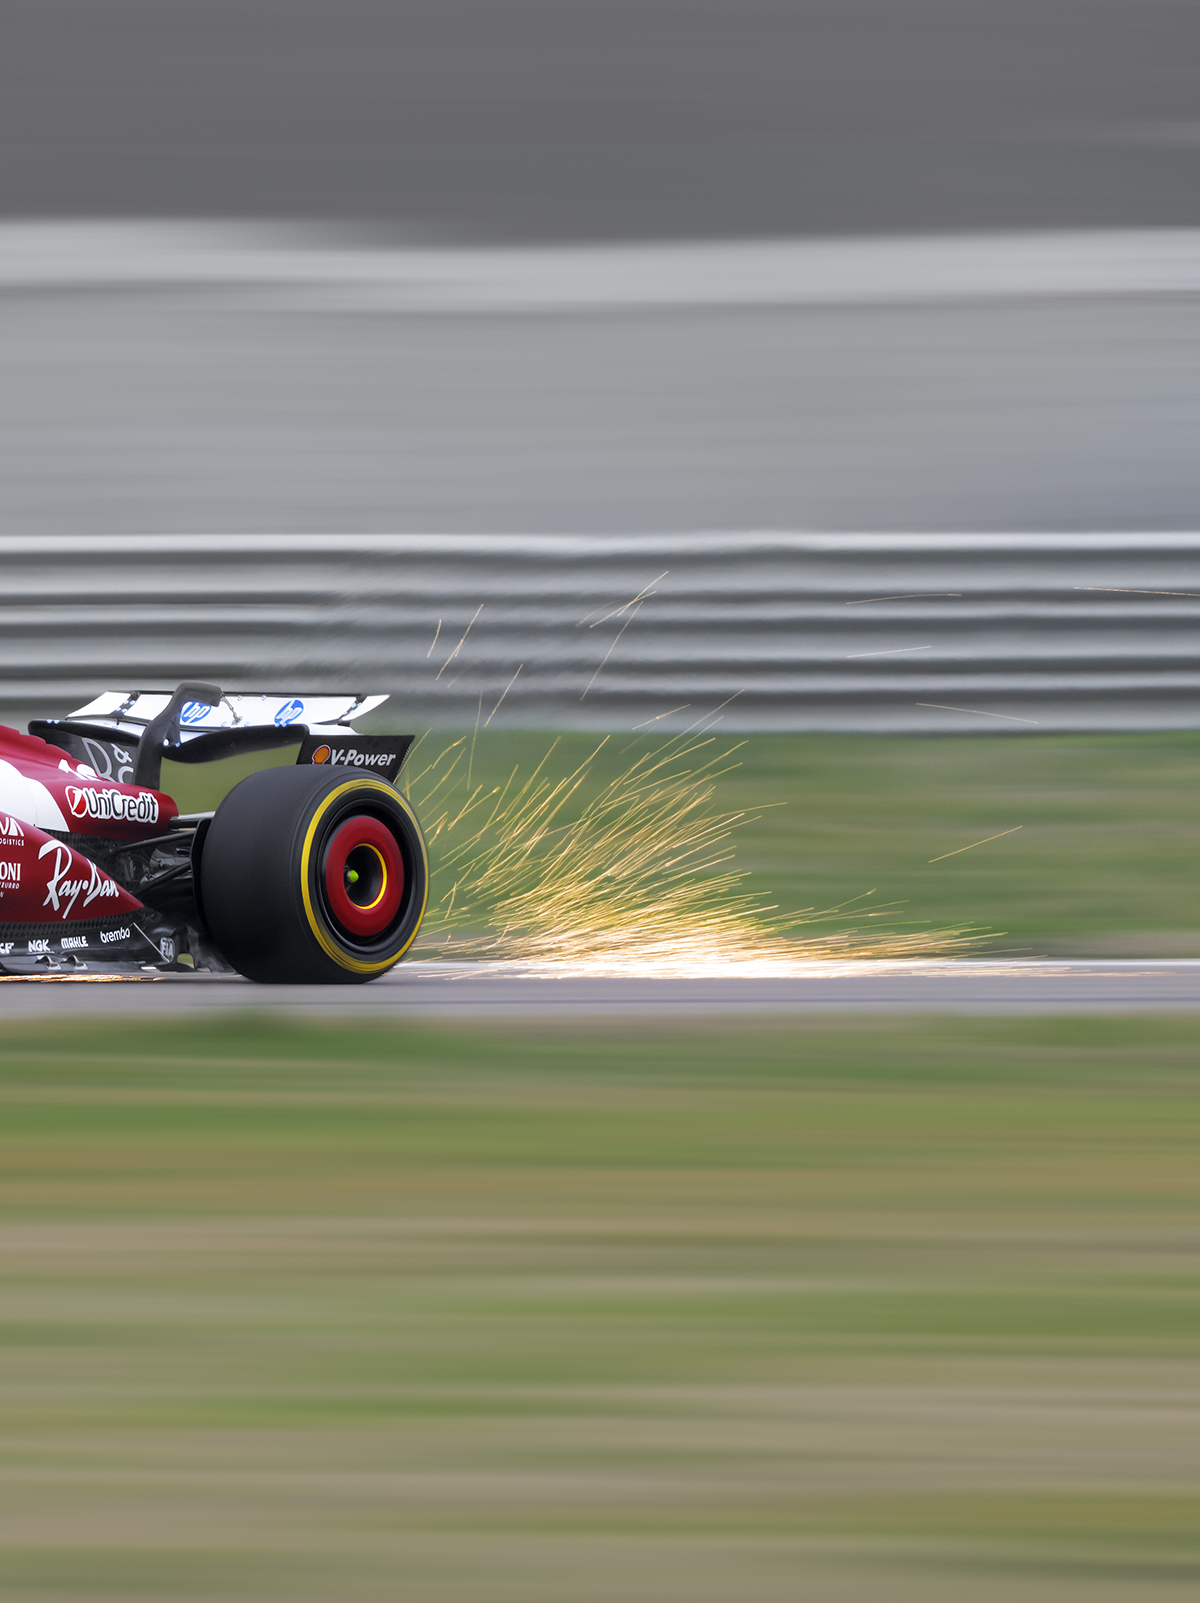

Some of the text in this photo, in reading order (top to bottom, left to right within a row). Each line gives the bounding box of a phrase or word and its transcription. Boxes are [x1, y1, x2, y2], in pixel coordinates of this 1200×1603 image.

[180, 701, 211, 724] hp
[275, 700, 304, 727] hp
[331, 749, 397, 766] V-Power
[83, 788, 159, 823] UniCredit
[61, 936, 88, 949] MAHLE
[100, 928, 130, 943] brembo
[28, 939, 50, 952] NGK
